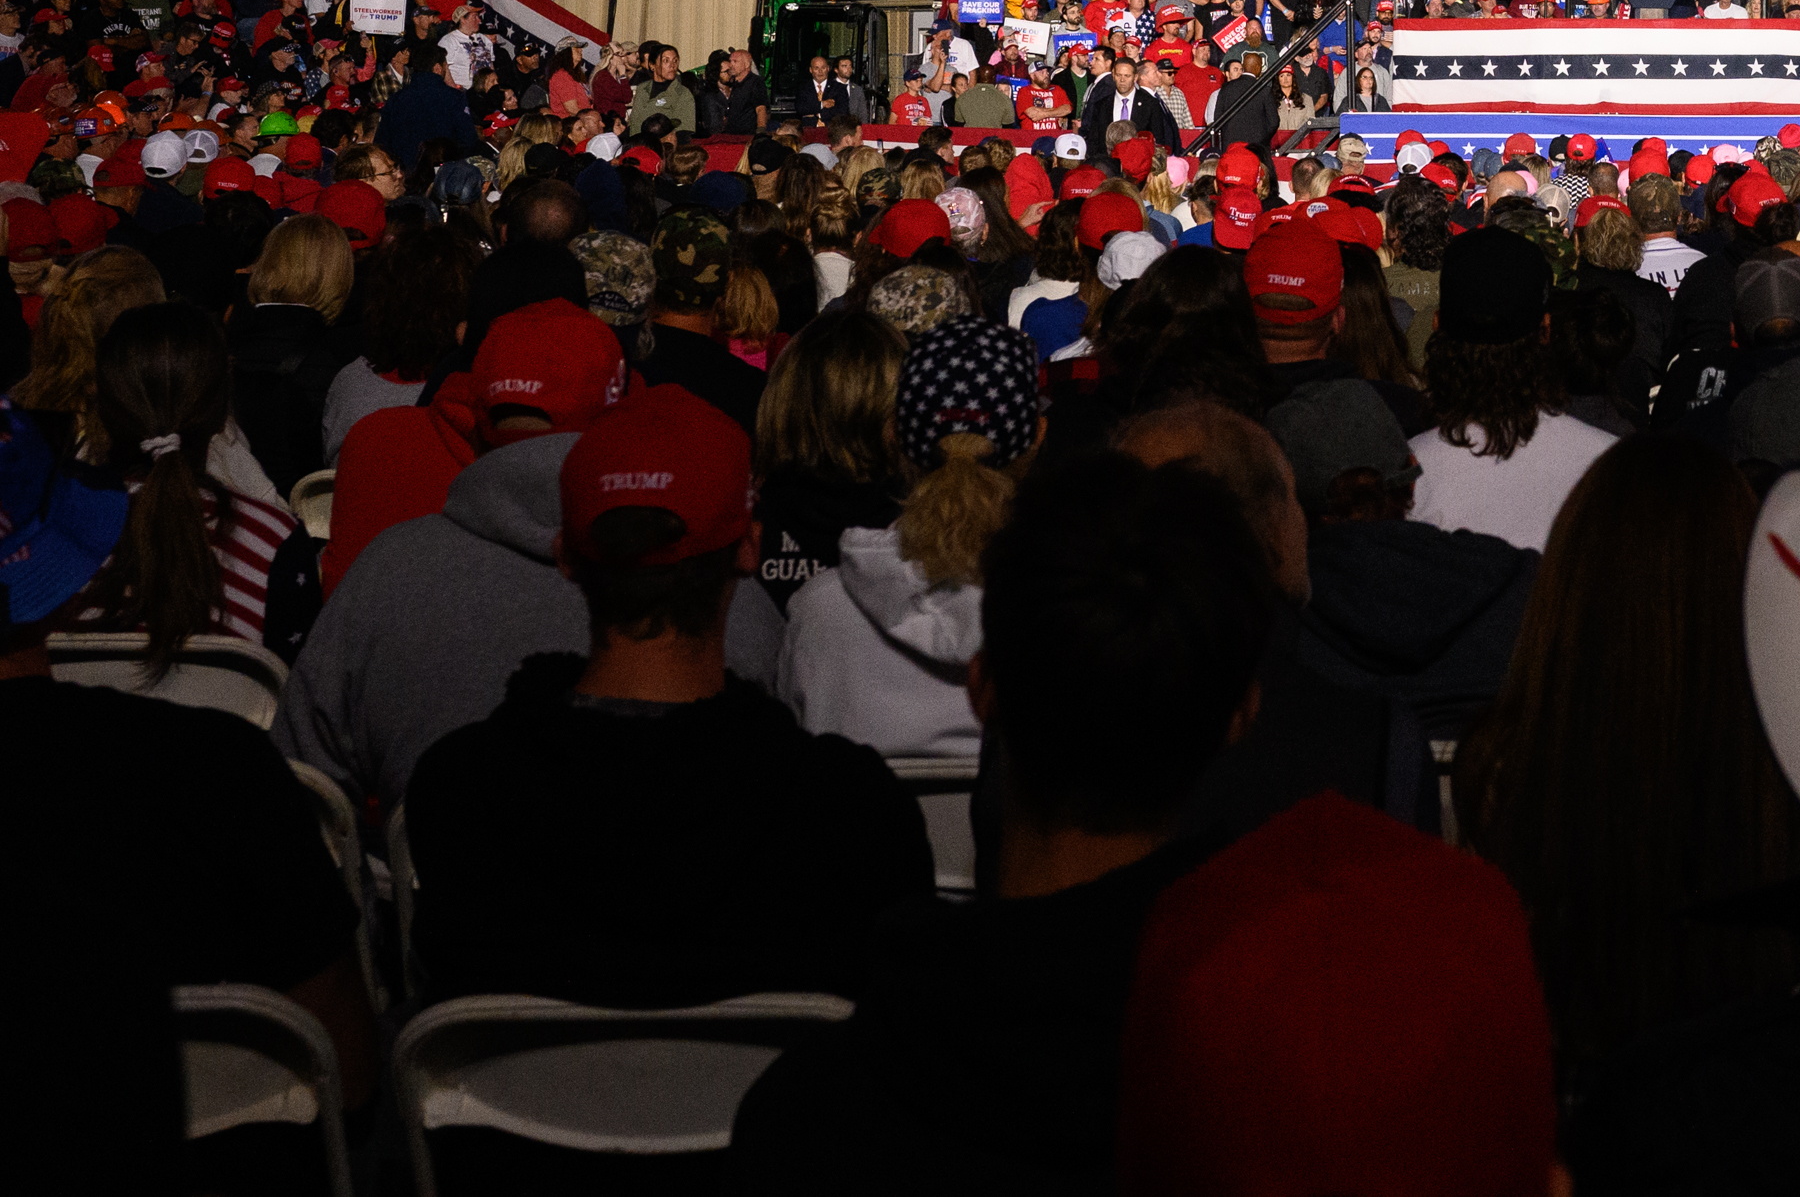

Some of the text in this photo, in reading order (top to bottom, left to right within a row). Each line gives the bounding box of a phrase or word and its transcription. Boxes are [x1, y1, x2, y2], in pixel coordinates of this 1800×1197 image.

[354, 7, 402, 16] STEELWORKERS
[1221, 31, 1235, 44] SAVE
[1033, 122, 1057, 130] MAGA
[1758, 197, 1781, 207] TRUMP
[1229, 206, 1256, 221] Trump
[1267, 274, 1305, 287] TRUMP
[489, 379, 543, 396] TRUMP
[601, 472, 675, 492] TRUMP
